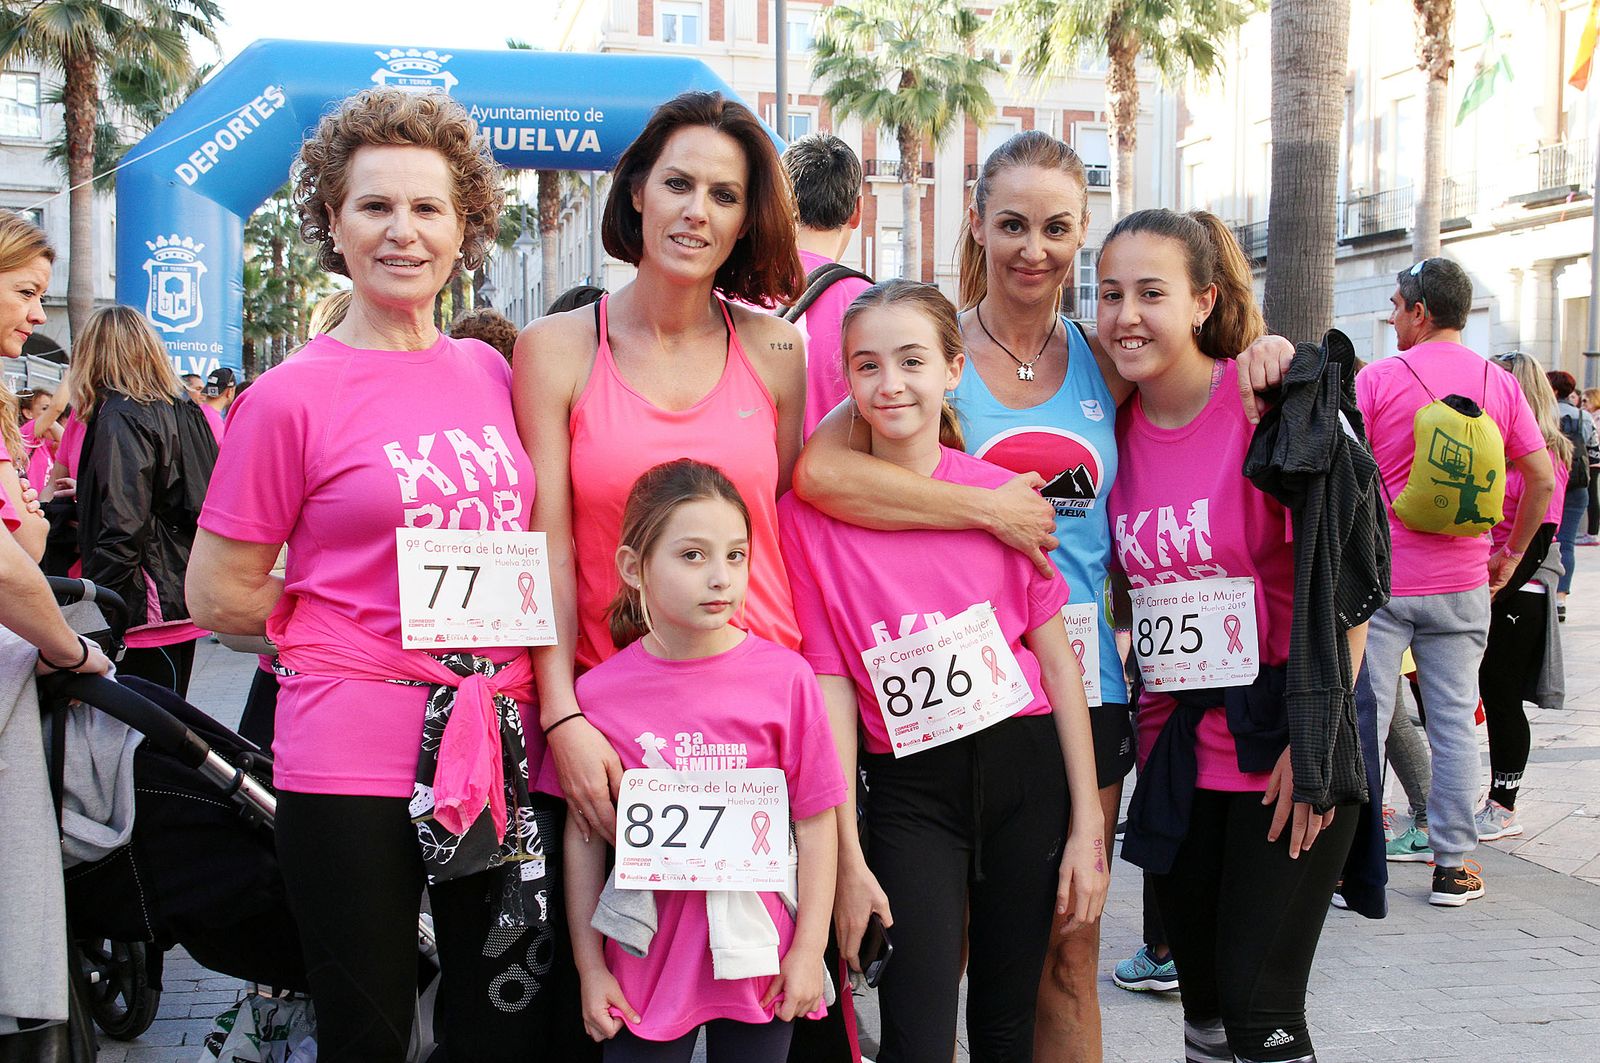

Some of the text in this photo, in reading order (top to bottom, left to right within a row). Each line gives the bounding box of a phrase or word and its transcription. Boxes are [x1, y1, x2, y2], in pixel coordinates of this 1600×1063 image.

[470, 103, 604, 123] Ayuntamiento de
[174, 84, 286, 187] DEPORTES
[164, 339, 224, 353] miento de
[170, 355, 221, 377] LVA
[382, 424, 519, 504] KM
[1069, 499, 1091, 508] Trail
[1055, 508, 1087, 519] HUELVA
[1115, 497, 1213, 572] KM
[424, 540, 471, 553] Carrera
[475, 542, 489, 554] de
[492, 543, 503, 555] la
[507, 544, 539, 558] Mujer
[495, 559, 541, 567] Huelva 2019
[424, 565, 481, 609] 77
[1147, 596, 1178, 608] Carrera
[1181, 590, 1195, 604] de
[1198, 591, 1209, 602] la
[1213, 589, 1247, 603] Mujer
[1228, 601, 1247, 610] 2019
[1063, 613, 1092, 627] Mujer
[890, 643, 935, 663] Carrera
[937, 635, 952, 648] de
[953, 629, 964, 640] la
[964, 617, 990, 635] Mujer
[959, 629, 994, 650] Huelva 2019
[1075, 626, 1092, 635] 2019
[1137, 613, 1203, 657] 825
[882, 654, 973, 717] 826
[692, 743, 748, 757] CARRERA
[648, 779, 699, 793] Carrera
[704, 781, 720, 794] de
[725, 781, 737, 793] la
[741, 781, 779, 796] Mujer
[1494, 770, 1523, 790] PU
[727, 797, 780, 806] Huelva 2019
[624, 803, 726, 849] 827
[1263, 1035, 1295, 1048] adidas
